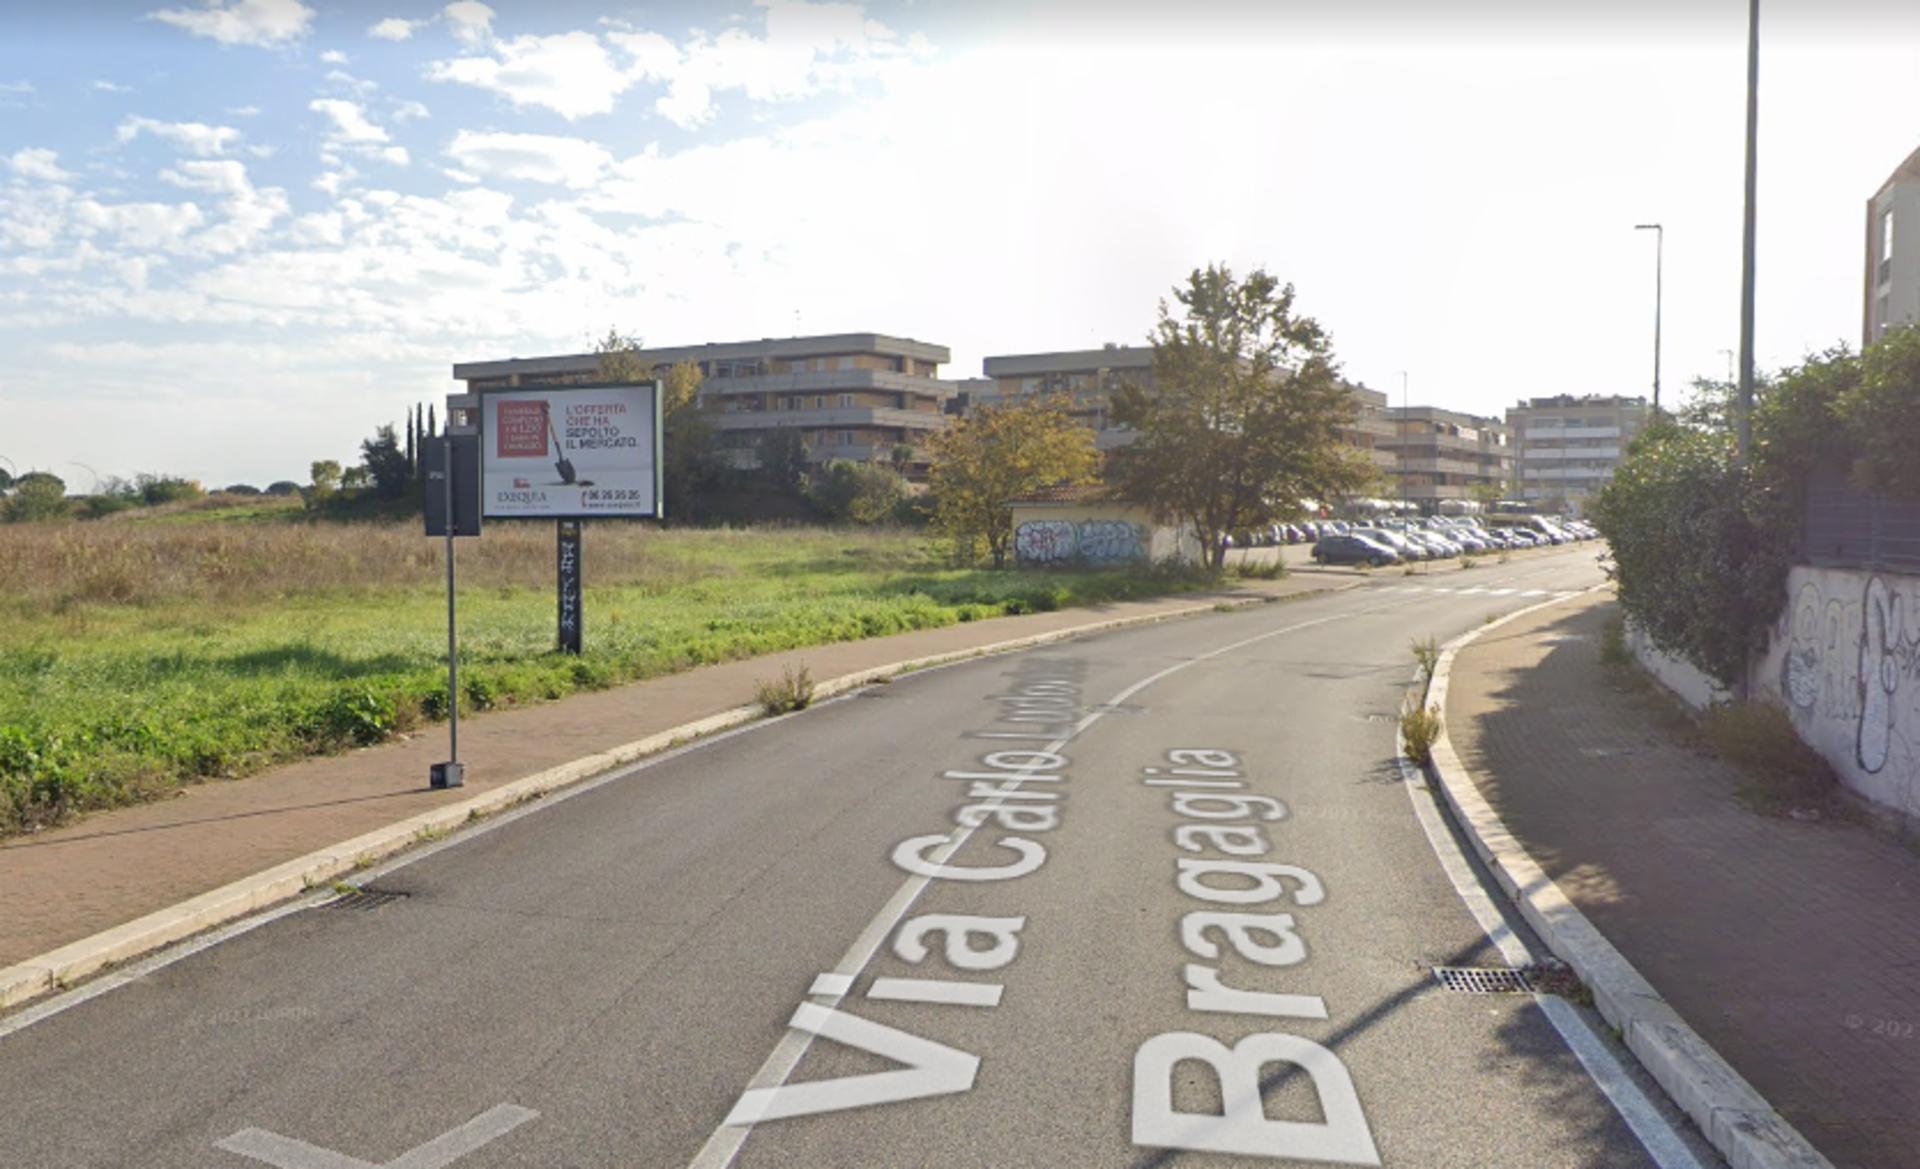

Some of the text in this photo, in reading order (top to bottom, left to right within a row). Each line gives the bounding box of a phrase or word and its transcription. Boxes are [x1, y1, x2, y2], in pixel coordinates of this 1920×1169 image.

[566, 403, 627, 416] L'OFFERTA
[566, 415, 610, 426] CHE HA
[566, 426, 620, 438] SEPOLTO
[566, 438, 576, 450] IL
